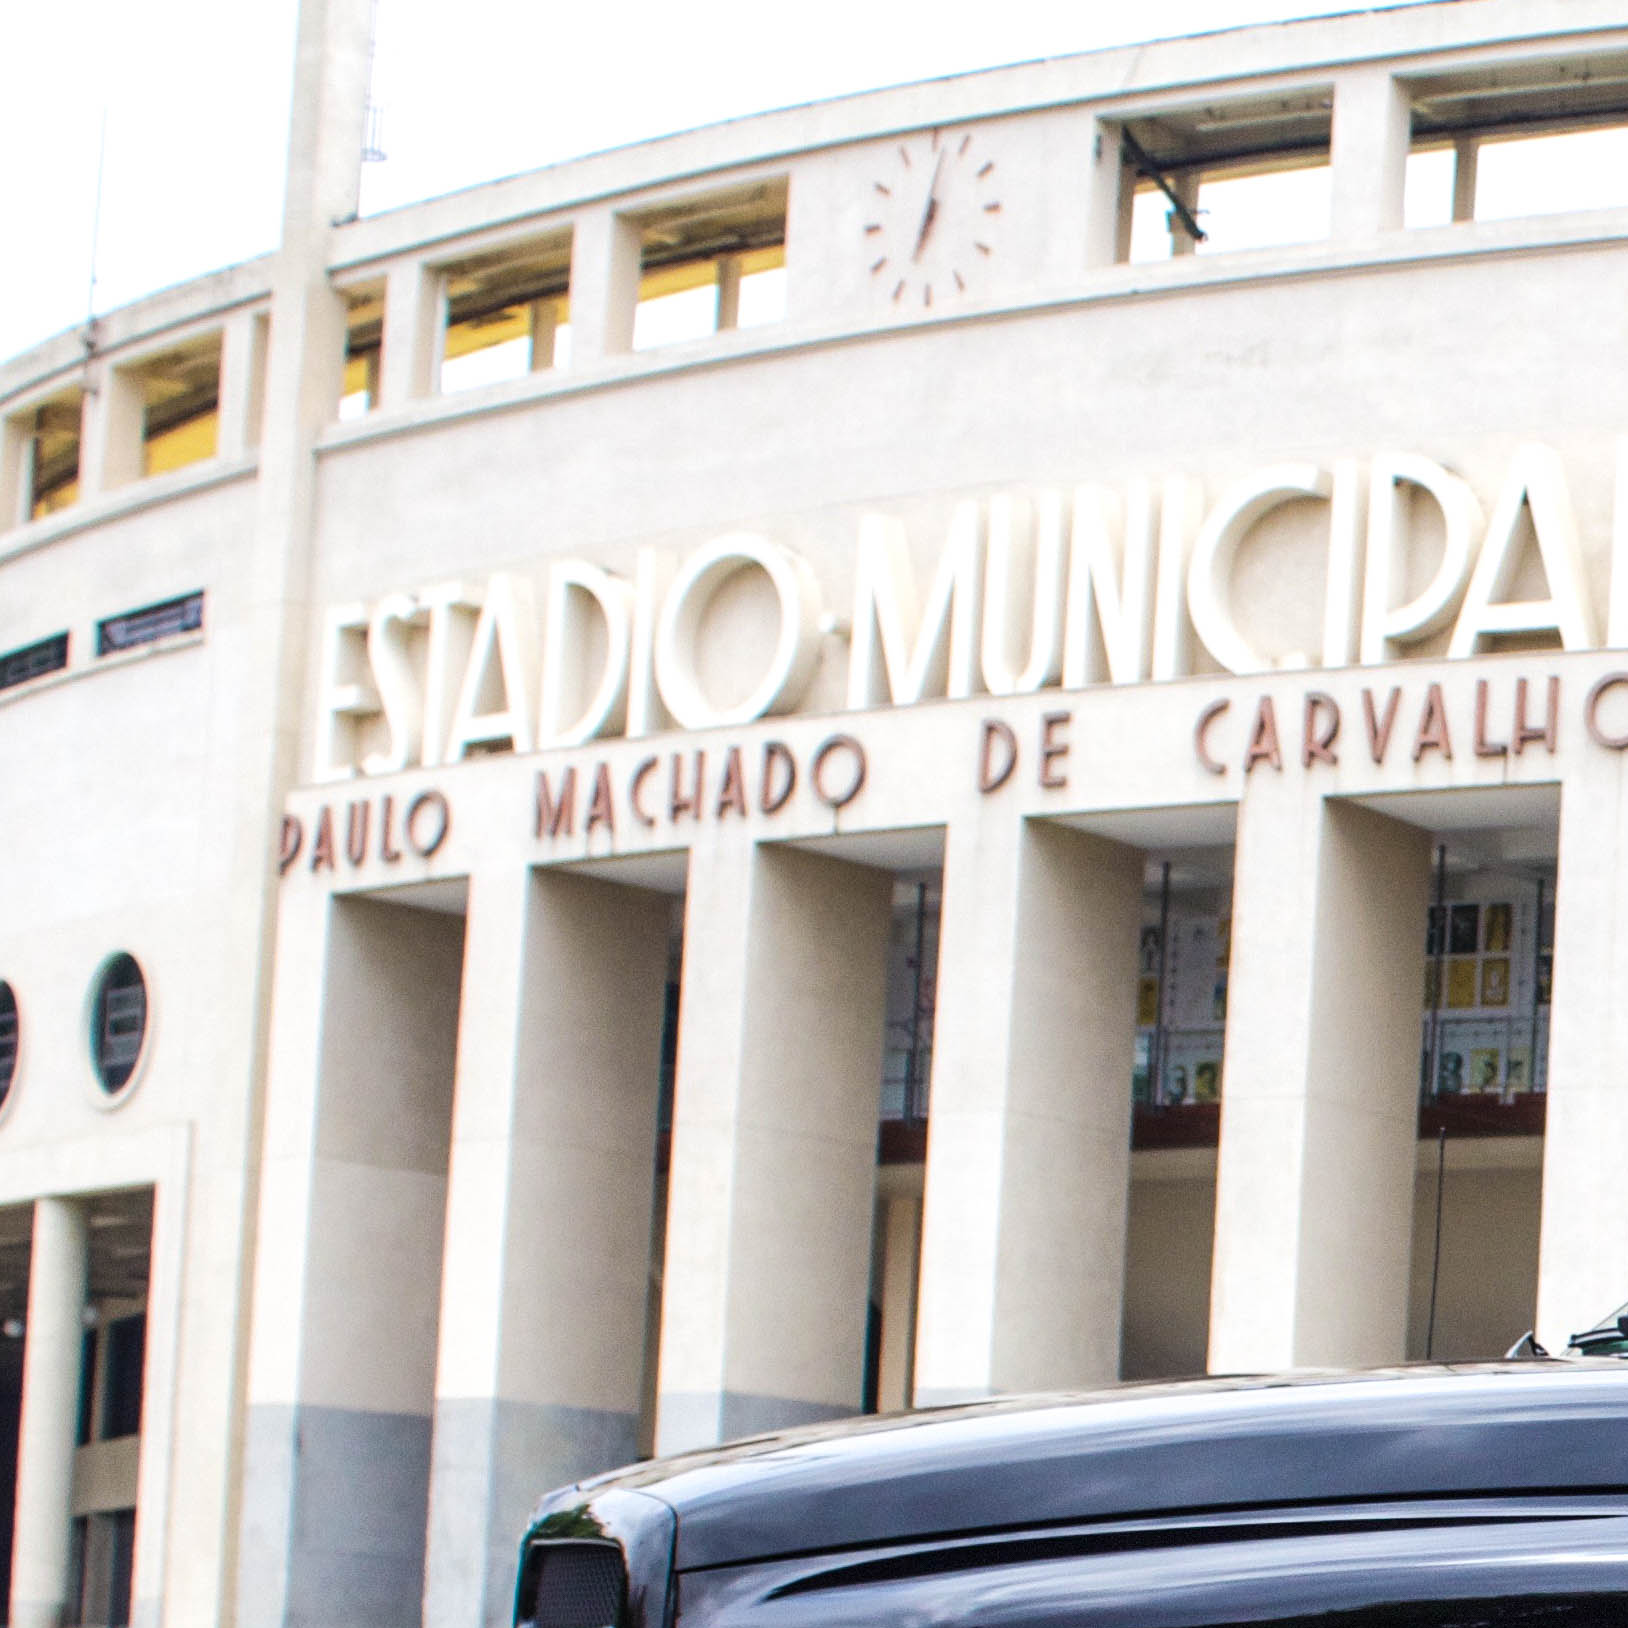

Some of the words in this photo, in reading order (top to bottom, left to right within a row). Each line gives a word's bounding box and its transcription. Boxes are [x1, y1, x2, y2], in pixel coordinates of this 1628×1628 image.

[312, 530, 820, 784] ESTADIO
[278, 788, 451, 877] PAULO
[534, 733, 869, 840] MACHADO
[978, 710, 1072, 795] DE
